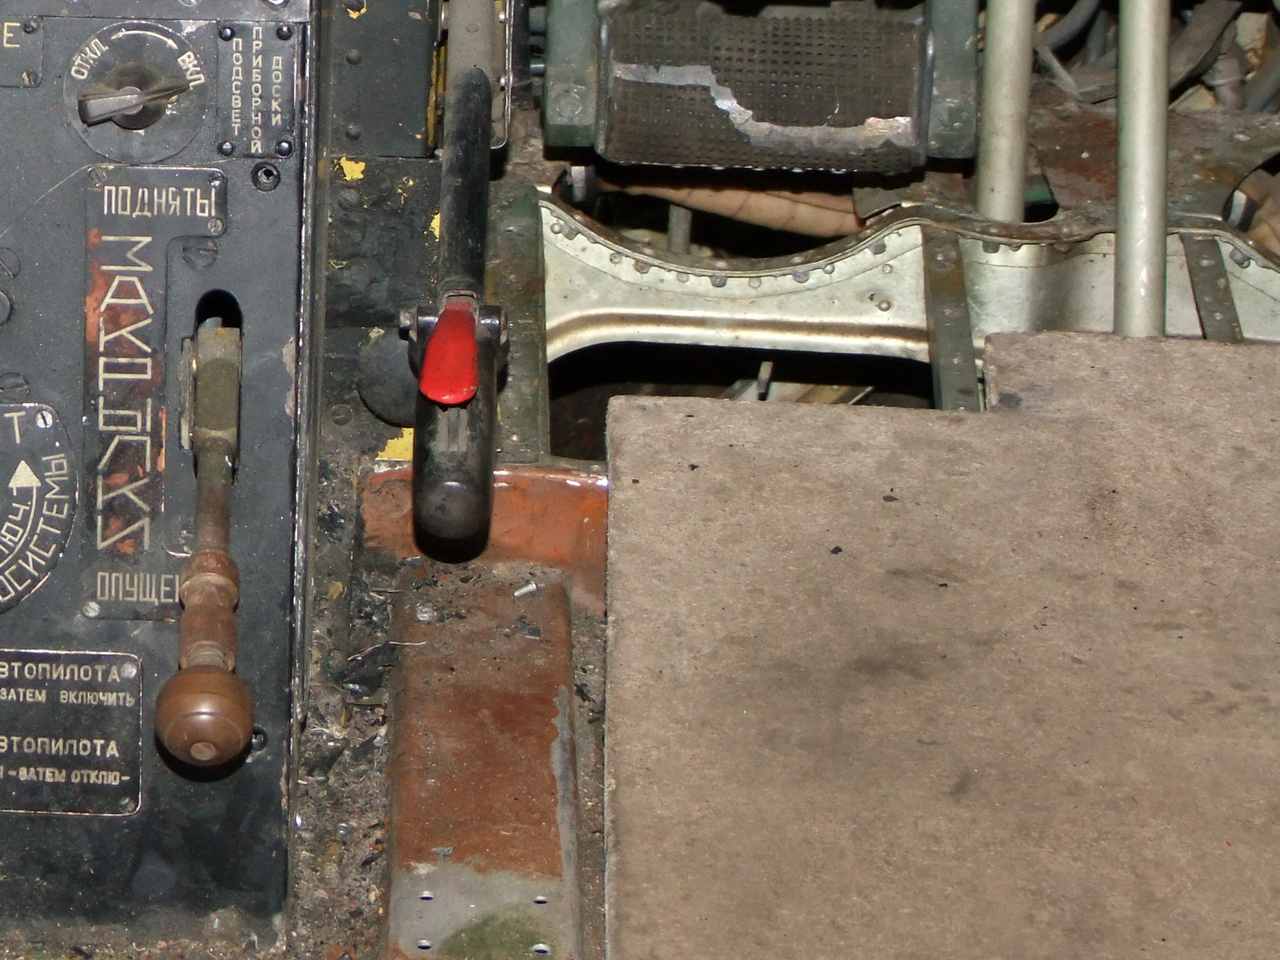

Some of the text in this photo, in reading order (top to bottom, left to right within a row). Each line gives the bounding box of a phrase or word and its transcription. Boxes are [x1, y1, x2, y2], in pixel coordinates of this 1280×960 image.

[231, 38, 243, 137] ПОДСВЕТ
[250, 26, 263, 154] ПРИБОРНОЙ
[271, 56, 283, 127] ДОСКИ
[103, 186, 217, 218] ПОДНЯТЫ
[97, 235, 154, 551] ЗАКРЫЛКИ
[0, 687, 47, 704] ЗАТЕМ
[60, 690, 135, 708] ВКЛЮЧИТЬ
